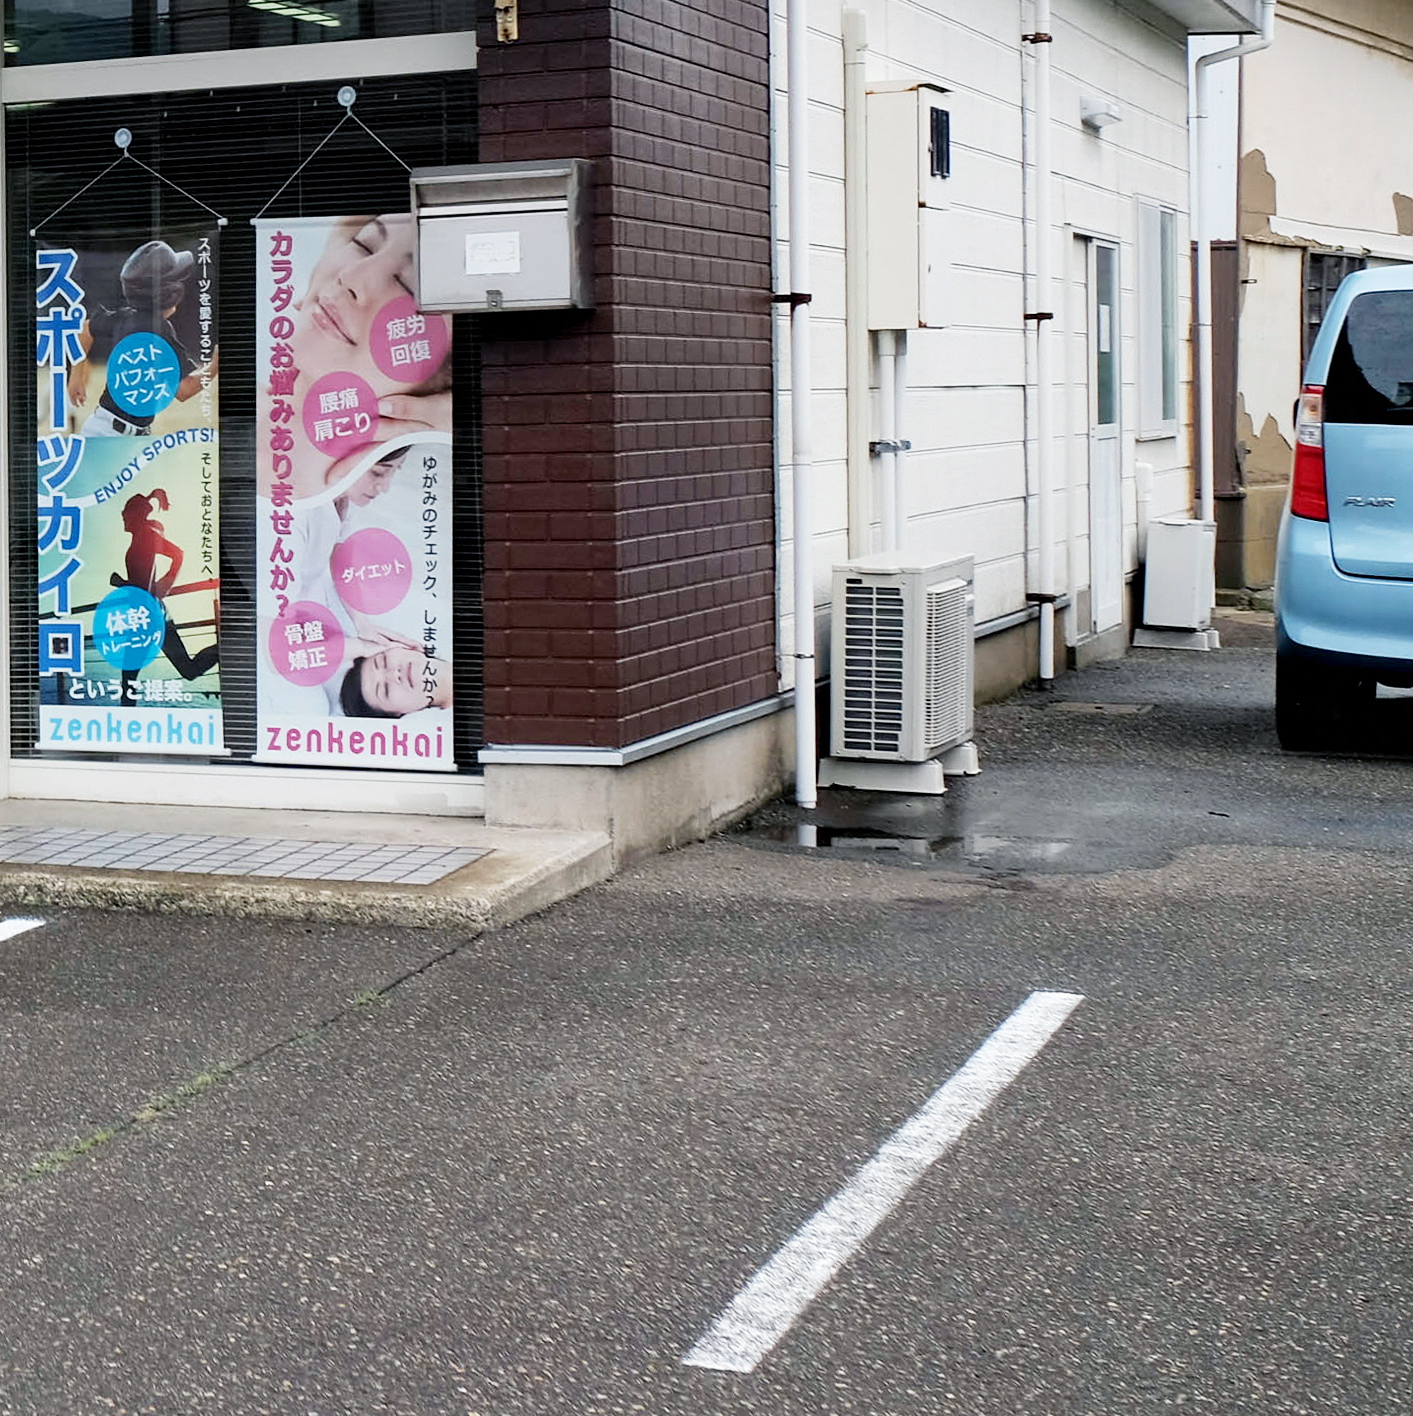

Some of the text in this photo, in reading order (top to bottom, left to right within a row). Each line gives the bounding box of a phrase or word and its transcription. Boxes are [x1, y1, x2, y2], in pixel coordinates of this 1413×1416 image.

[386, 314, 426, 339] 疲労
[118, 344, 163, 365] ベスト
[390, 340, 432, 367] 回復
[114, 365, 174, 389] パフォー
[123, 383, 171, 406] マンス
[319, 388, 360, 414] 腰痛
[314, 412, 372, 442] 肩こり
[94, 427, 215, 505] ENJOY SPORTS!
[341, 559, 406, 584] ダイエット
[105, 605, 151, 637] 体幹
[285, 620, 324, 645] 骨盤
[100, 630, 162, 657] トレーニング
[288, 647, 328, 672] 矯正
[49, 712, 215, 746] zenkenkai
[267, 722, 443, 758] zenkenkai
